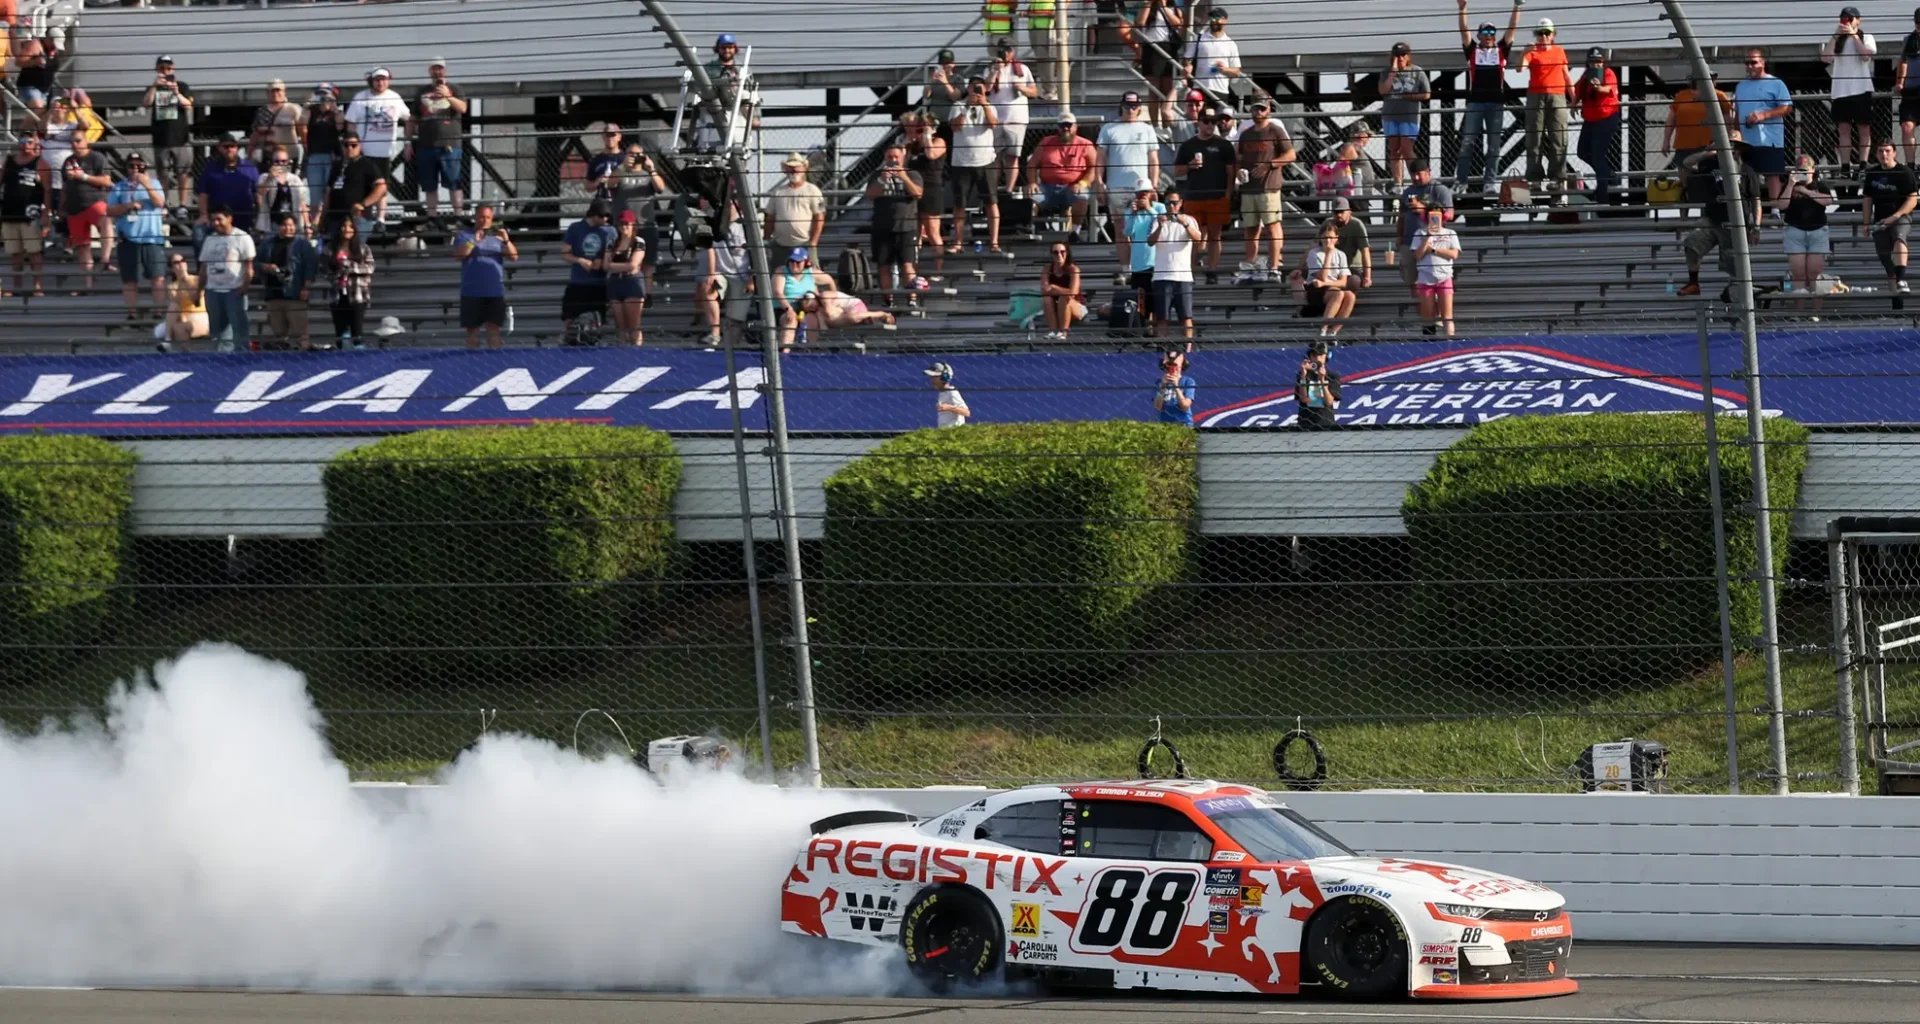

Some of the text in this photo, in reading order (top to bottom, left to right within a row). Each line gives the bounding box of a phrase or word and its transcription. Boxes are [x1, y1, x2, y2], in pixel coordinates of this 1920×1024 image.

[0, 366, 769, 416] YLVANIA
[1457, 379, 1594, 392] GREAT
[1332, 392, 1618, 410] MERICAN
[1604, 765, 1620, 779] 20
[941, 818, 967, 827] Blues
[806, 838, 1069, 897] REGISTIX
[1212, 871, 1236, 882] xfinity
[1326, 884, 1392, 900] GOODYEAR
[841, 907, 894, 918] WeatherTech
[1078, 869, 1198, 950] 88
[905, 894, 939, 962] GOODYEAR
[1531, 925, 1564, 937] CHEVROLET
[1460, 927, 1483, 944] 88
[1019, 940, 1058, 953] CAROLINA
[1422, 944, 1455, 953] SIMPSON
[973, 940, 991, 976] EAGLE
[1022, 951, 1057, 961] CARPORTS
[1418, 956, 1457, 965] ARP
[1317, 963, 1349, 989] EAGLE
